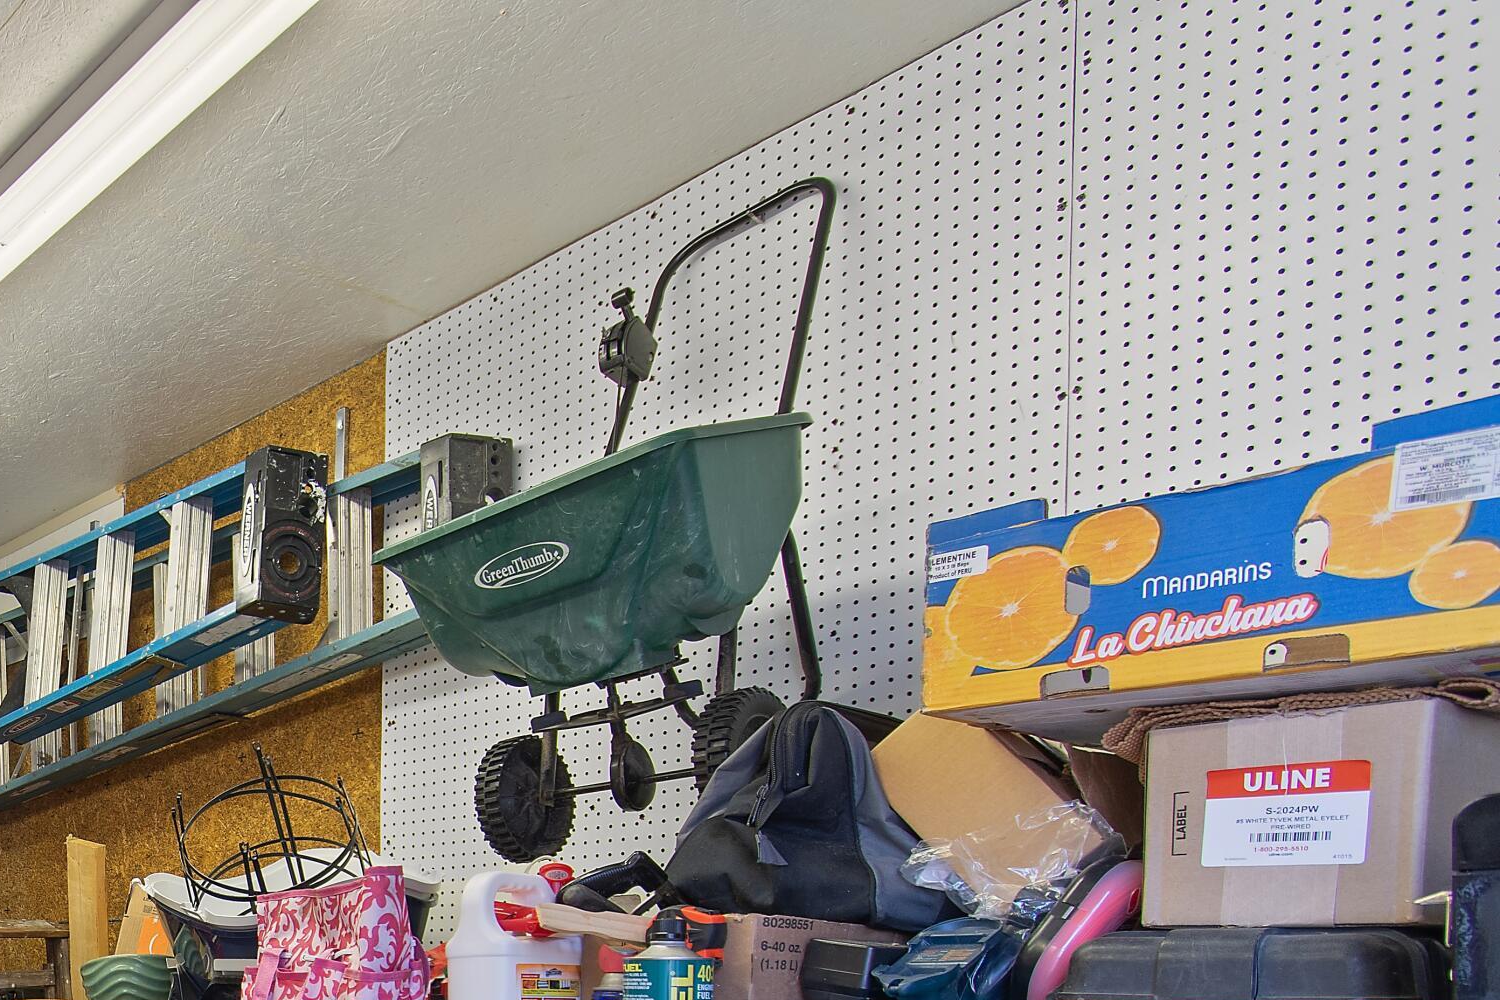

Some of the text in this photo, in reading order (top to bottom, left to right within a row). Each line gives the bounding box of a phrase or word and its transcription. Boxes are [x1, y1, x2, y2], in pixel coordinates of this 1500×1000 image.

[425, 497, 435, 529] WER
[243, 502, 253, 559] WERNER
[931, 551, 977, 566] LEMENTINE
[1072, 597, 1316, 664] La Chinchana
[1244, 767, 1331, 792] ULINE
[1265, 805, 1319, 815] S-2024PW
[1176, 805, 1187, 841] LABEL
[762, 916, 814, 931] 80298551
[760, 940, 803, 954] 6-40 oz.
[760, 958, 799, 973] (1.18 L)
